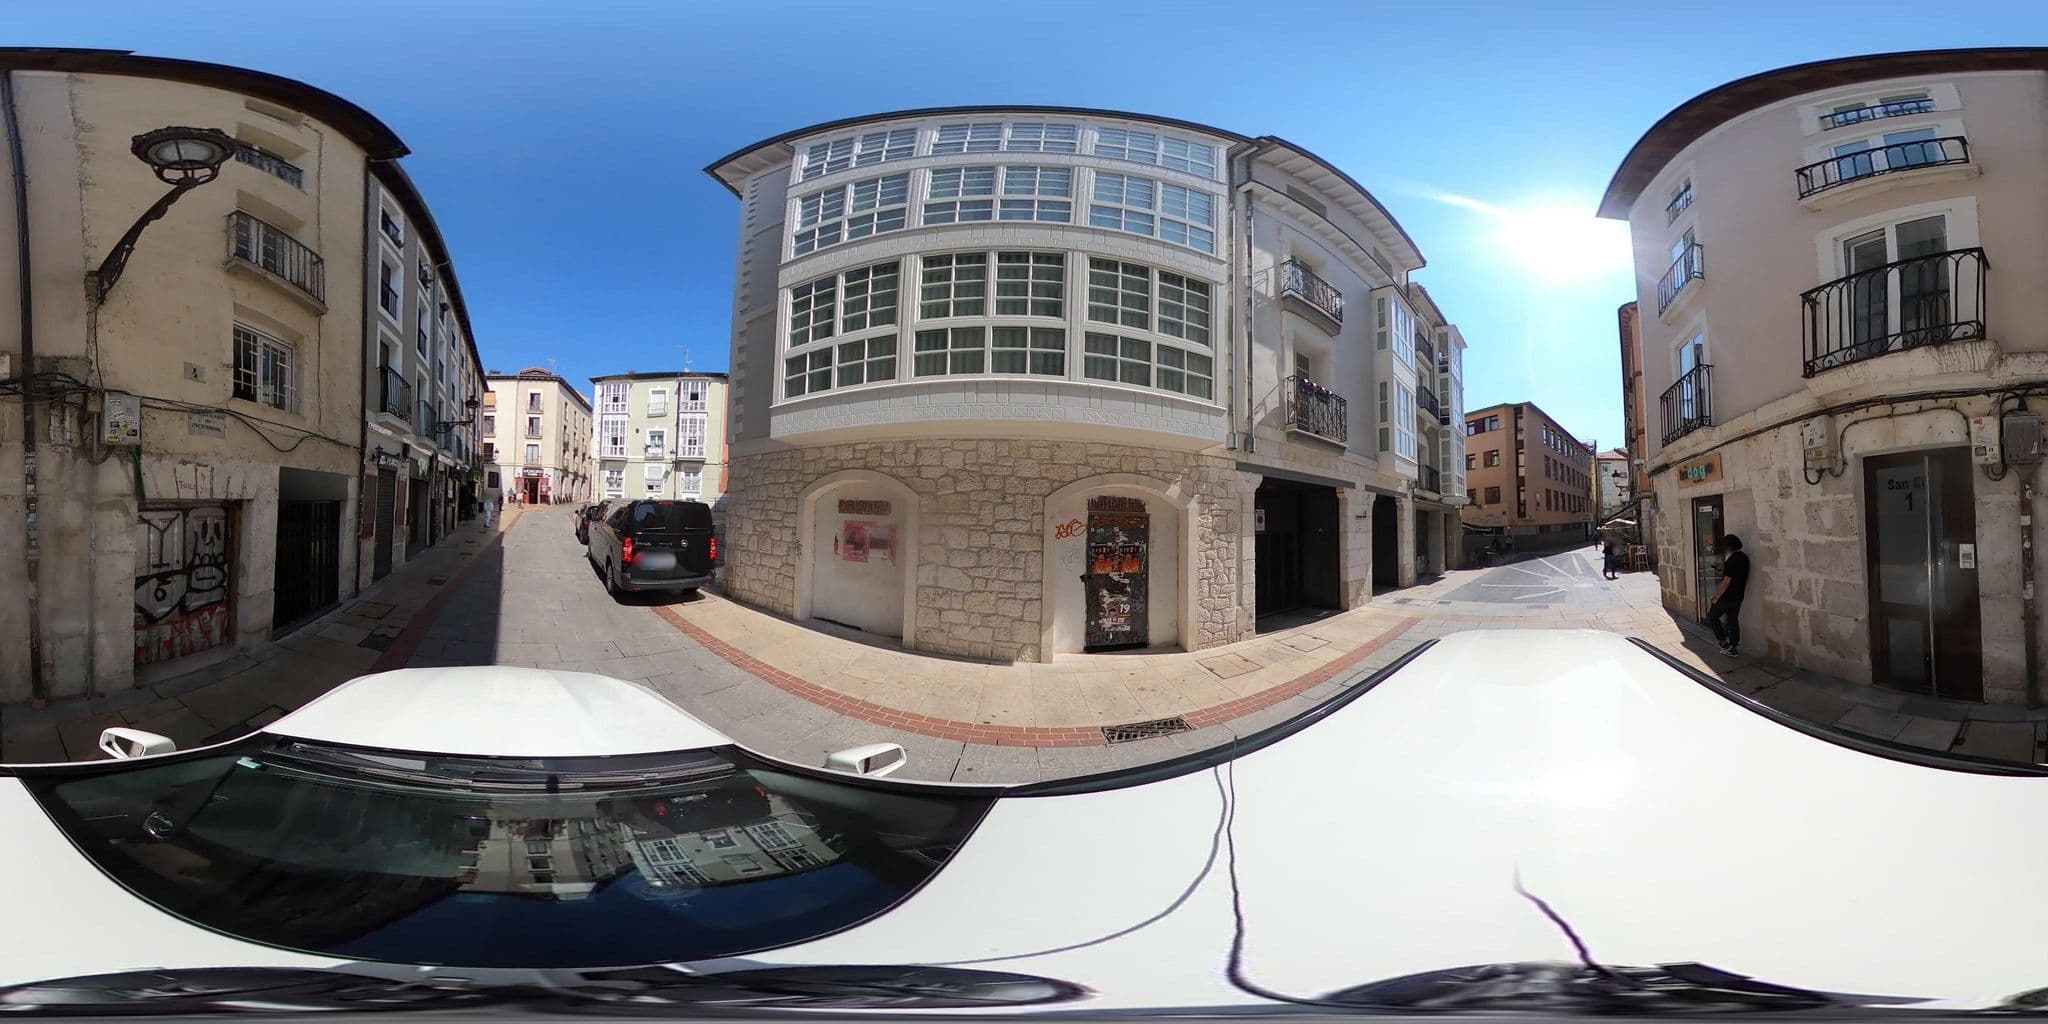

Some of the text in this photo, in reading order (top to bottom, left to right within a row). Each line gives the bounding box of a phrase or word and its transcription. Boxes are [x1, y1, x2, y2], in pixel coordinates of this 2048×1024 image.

[1887, 479, 1910, 491] San
[1904, 492, 1913, 512] 1
[1119, 603, 1131, 614] 19
